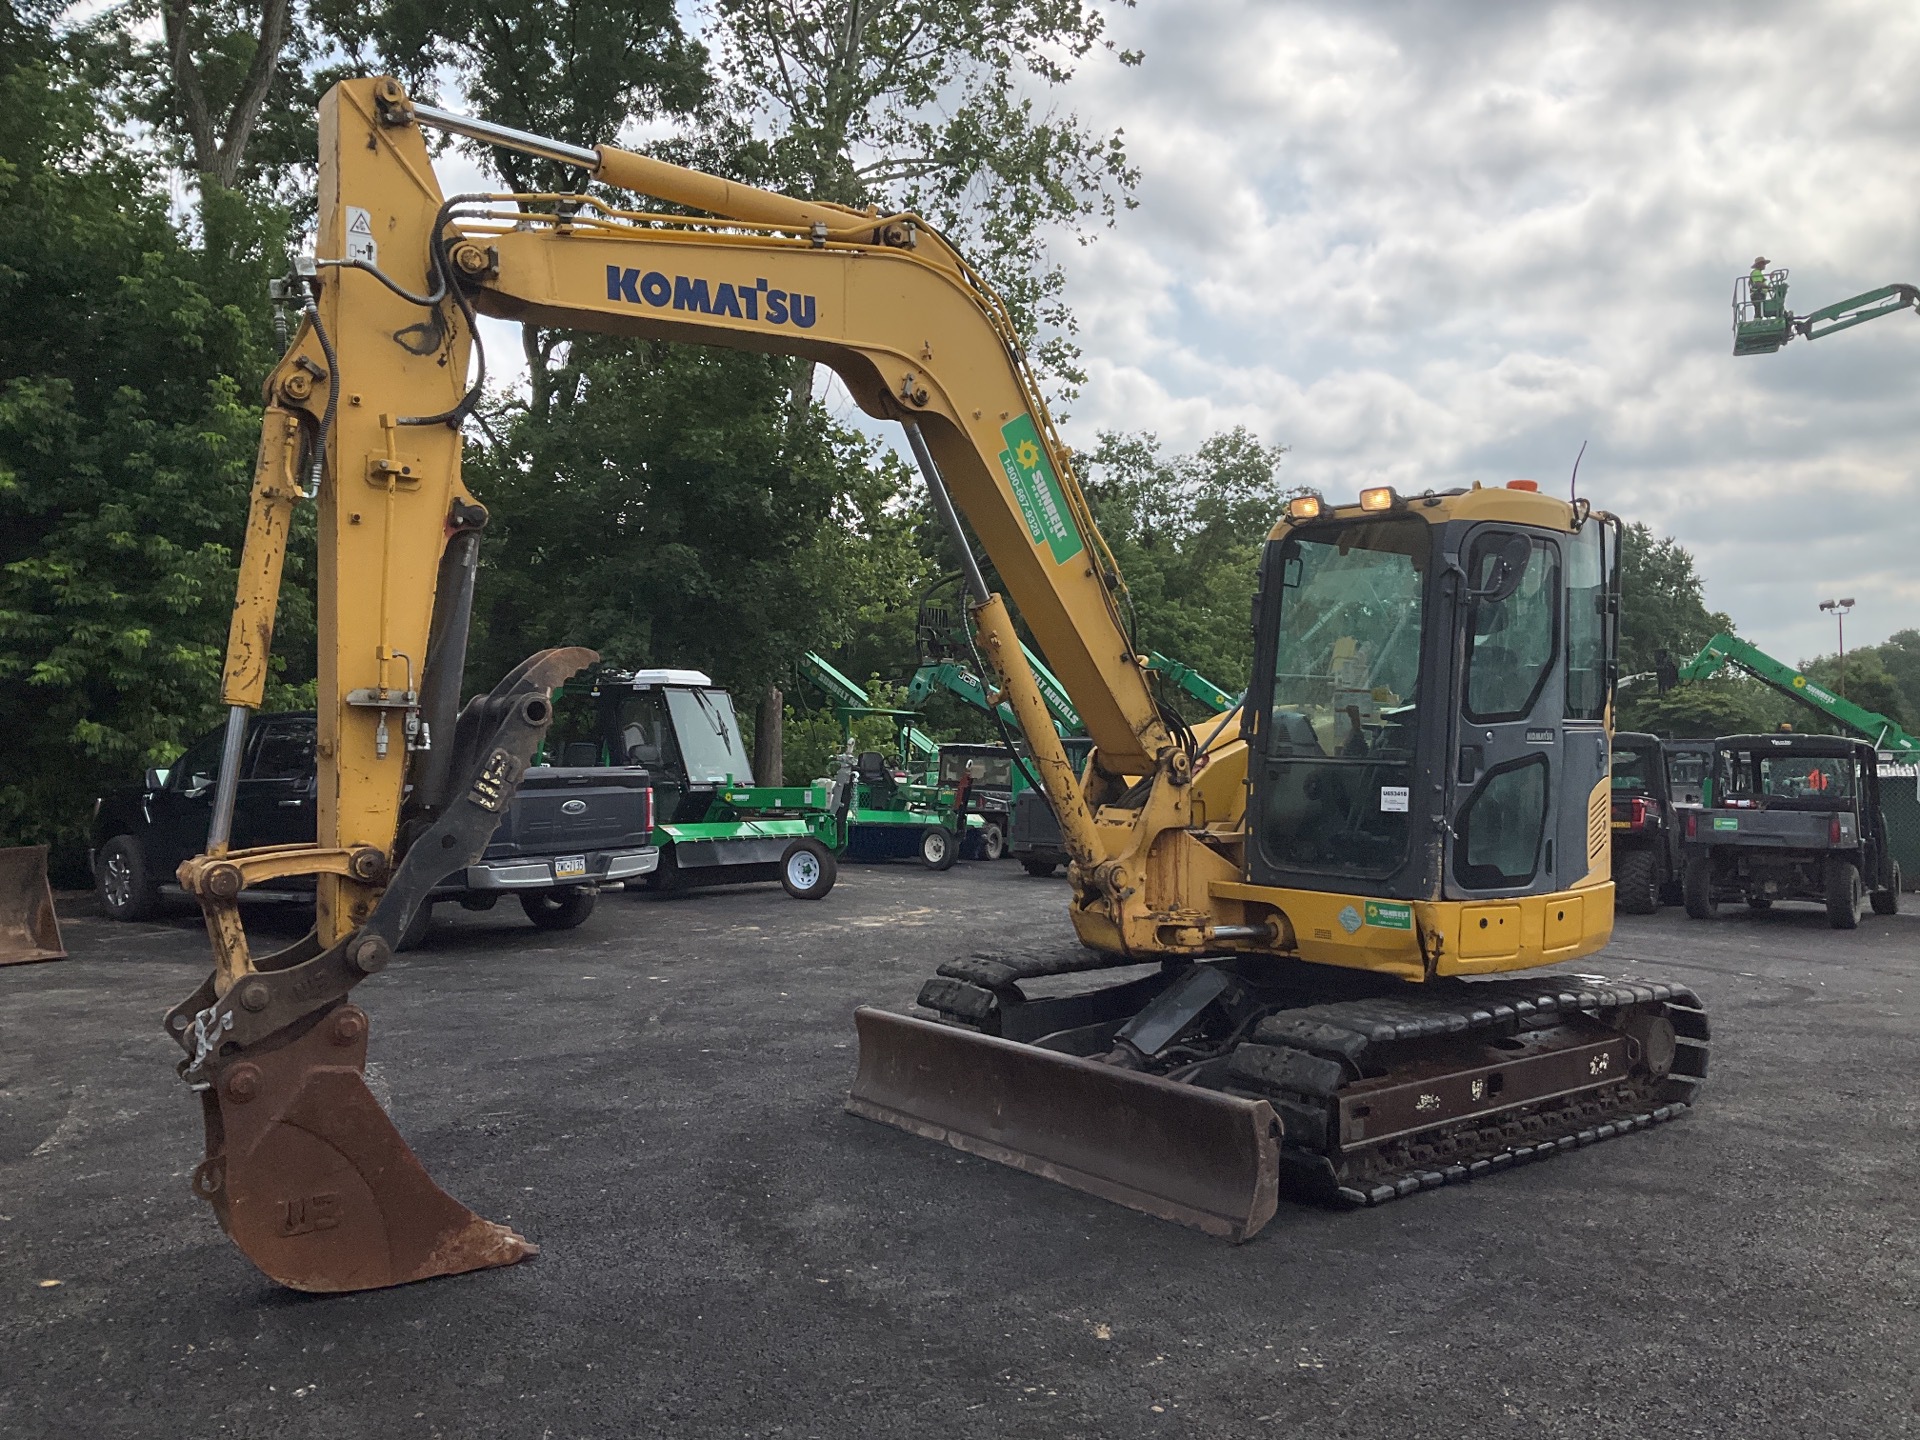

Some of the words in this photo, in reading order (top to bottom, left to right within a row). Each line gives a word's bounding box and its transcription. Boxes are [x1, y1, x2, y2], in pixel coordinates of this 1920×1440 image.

[606, 264, 816, 329] KOMATSU
[1003, 458, 1041, 537] 1-800-667-9328
[1031, 484, 1055, 534] RENTALS
[1032, 469, 1068, 539] SUNBELT
[818, 672, 849, 701] SUNBELT
[958, 671, 977, 687] JCB
[1043, 685, 1079, 725] RENTALS
